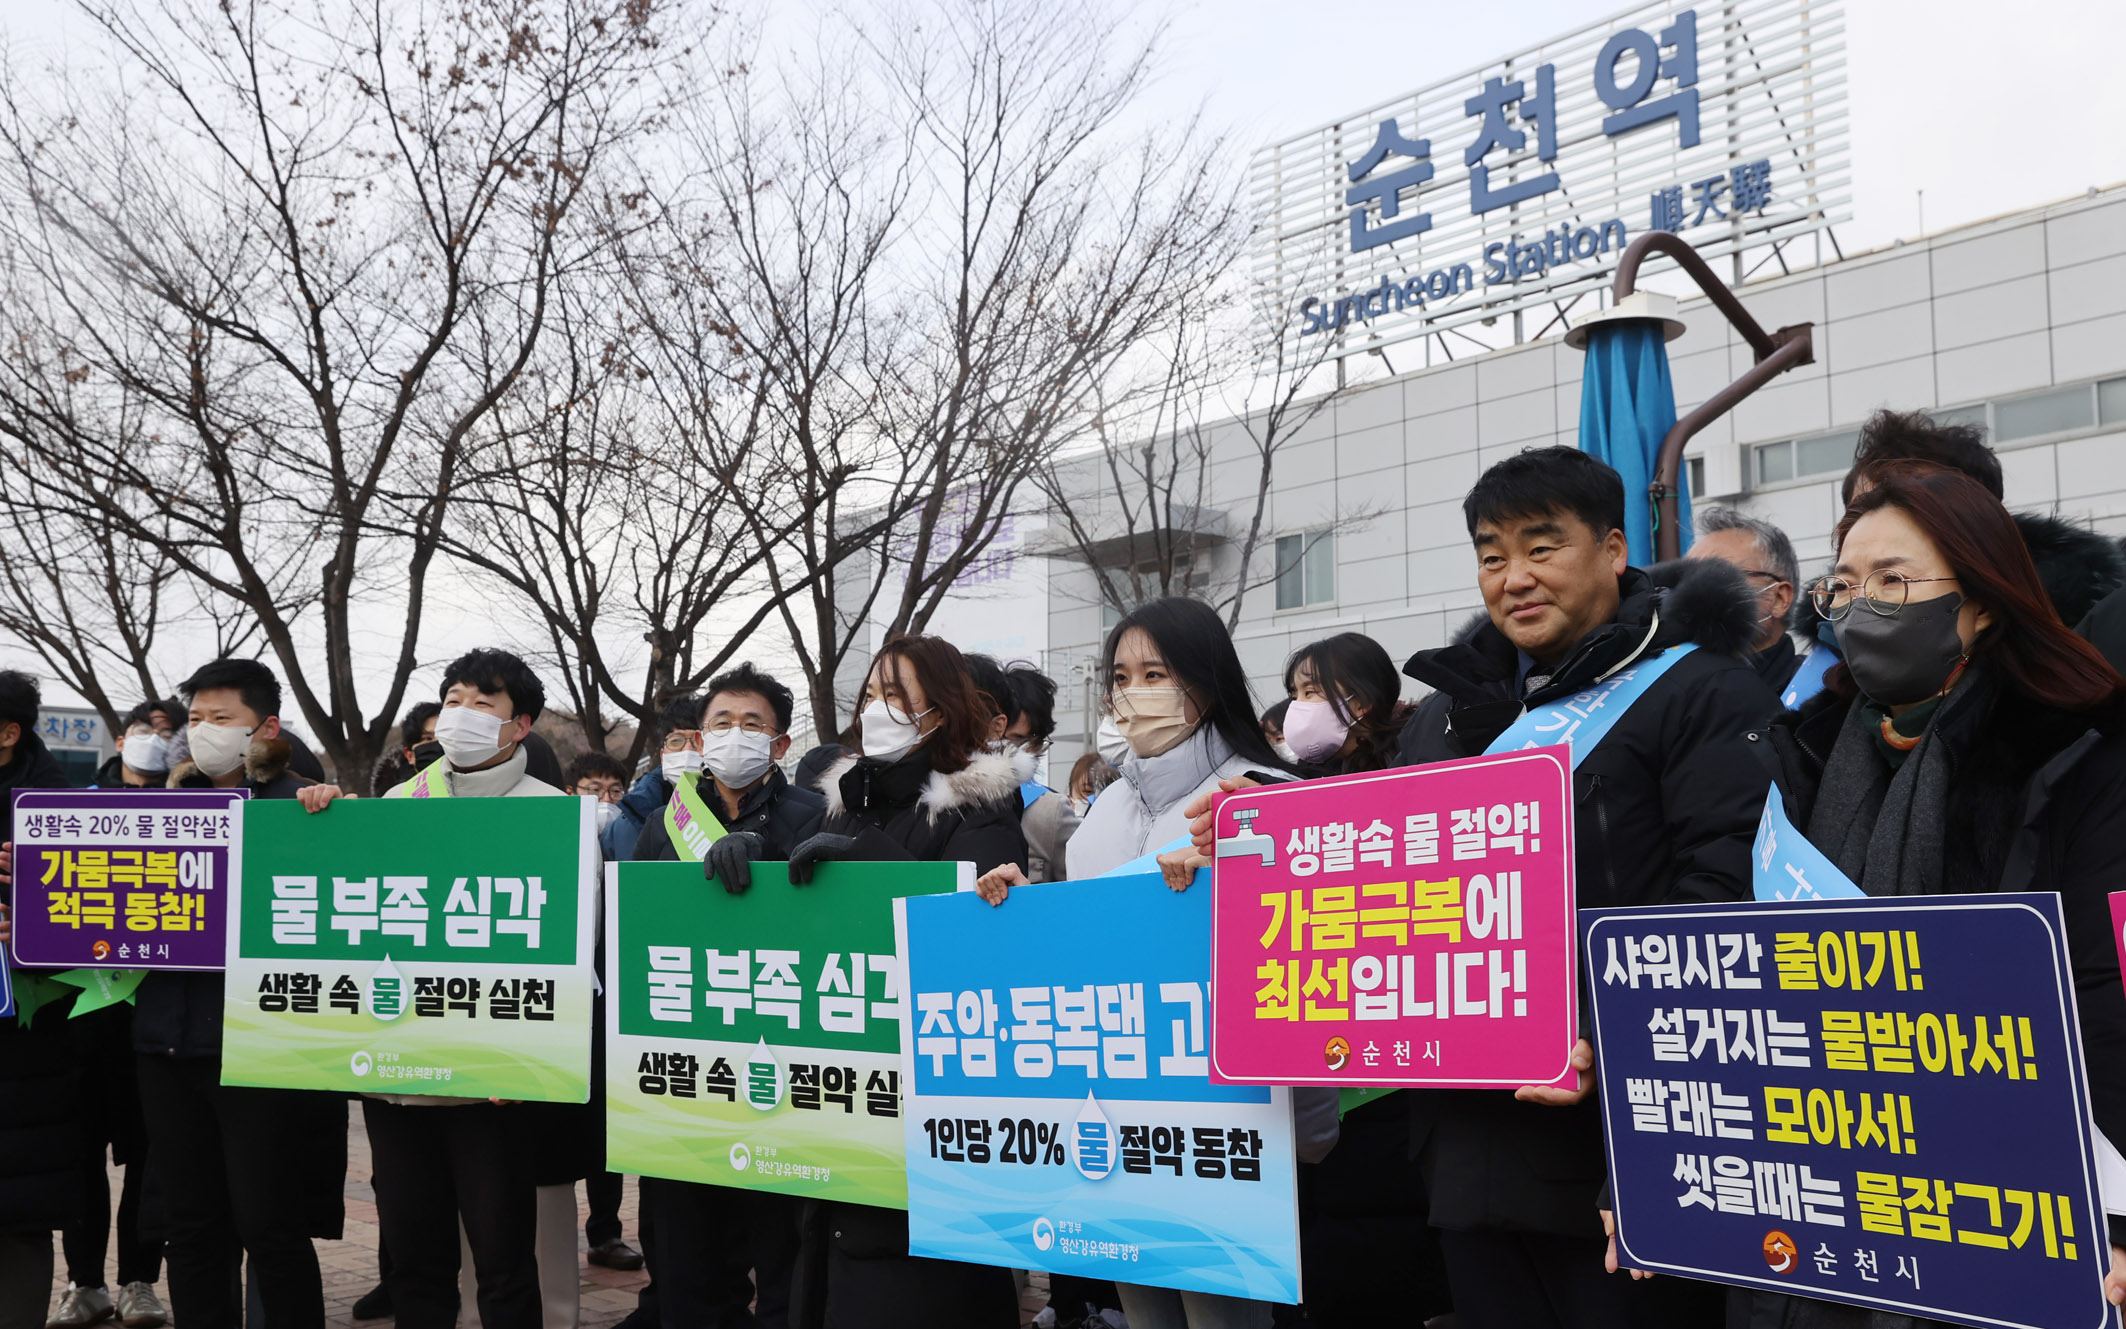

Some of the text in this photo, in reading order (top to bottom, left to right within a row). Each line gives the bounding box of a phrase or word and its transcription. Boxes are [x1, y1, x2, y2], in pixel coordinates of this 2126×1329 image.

[1346, 9, 1700, 252] 순천역
[1300, 218, 1626, 336] Suncheon Station
[33, 717, 96, 741] 차장
[25, 815, 82, 838] 생활속
[89, 815, 129, 836] 20%
[136, 815, 154, 838] 물
[1286, 801, 1542, 877] 생활속 물 절약!
[40, 850, 213, 890] 가뭄극복에
[47, 891, 205, 931] 적극 동참!
[271, 876, 548, 948] 물 부족 심각
[1259, 871, 1523, 951] 가뭄극복에
[118, 943, 169, 959] 순천시
[1602, 930, 1924, 991] 샤워시간 줄이기!
[258, 971, 555, 1021] 생활 속 물 절약 실천
[647, 945, 692, 1022] 물
[706, 948, 801, 1028] 부족
[1255, 949, 1528, 1022] 최선입니다!
[1159, 982, 1210, 1077] 고
[1362, 1039, 1441, 1067] 순천시
[1647, 1008, 2038, 1080] 설거지는 물받아서!
[637, 1050, 904, 1118] 생활 속 물 절약 실
[1625, 1077, 1917, 1155] 빨래는 모아서!
[756, 1160, 830, 1182] 영산강유역환경청
[923, 1118, 1263, 1182] 1인당 20% 물 절약 동참
[1059, 1221, 1082, 1234] 환경부
[1672, 1153, 2079, 1261] 씻을때는 물잠그기!
[1060, 1238, 1139, 1262] 영산강유역환경청
[1812, 1242, 1921, 1290] 순천시
